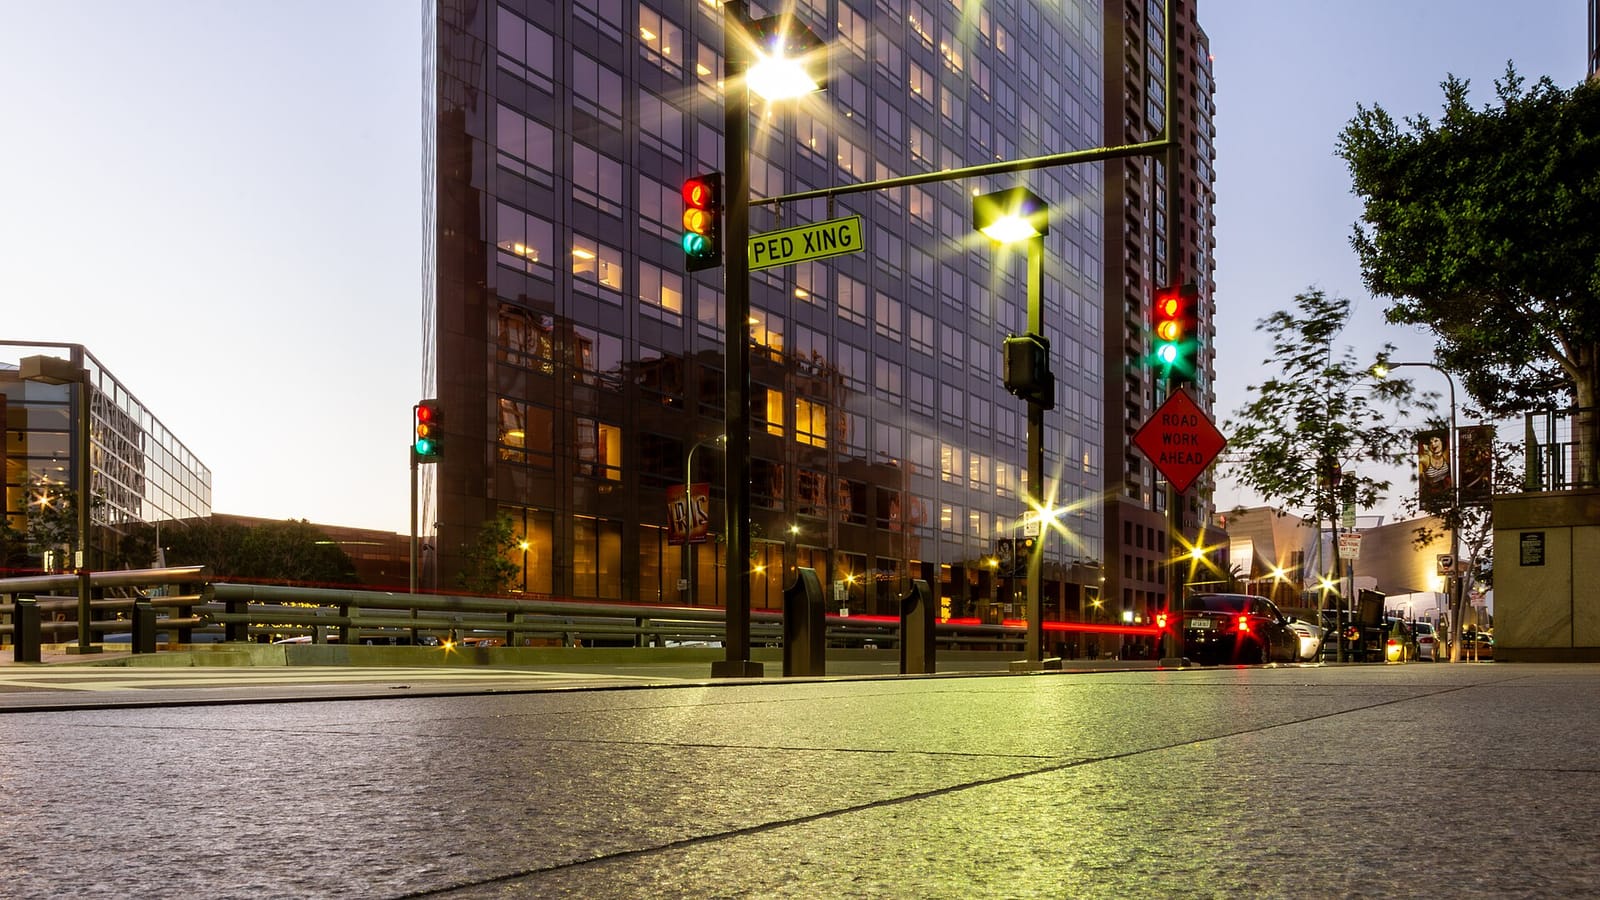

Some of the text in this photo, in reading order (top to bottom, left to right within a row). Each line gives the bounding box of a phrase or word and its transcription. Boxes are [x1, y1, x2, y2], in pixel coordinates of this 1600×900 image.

[754, 225, 852, 263] PED XING
[1162, 414, 1199, 427] ROAD
[1162, 433, 1199, 446] WORK
[1159, 452, 1203, 465] AHEAD
